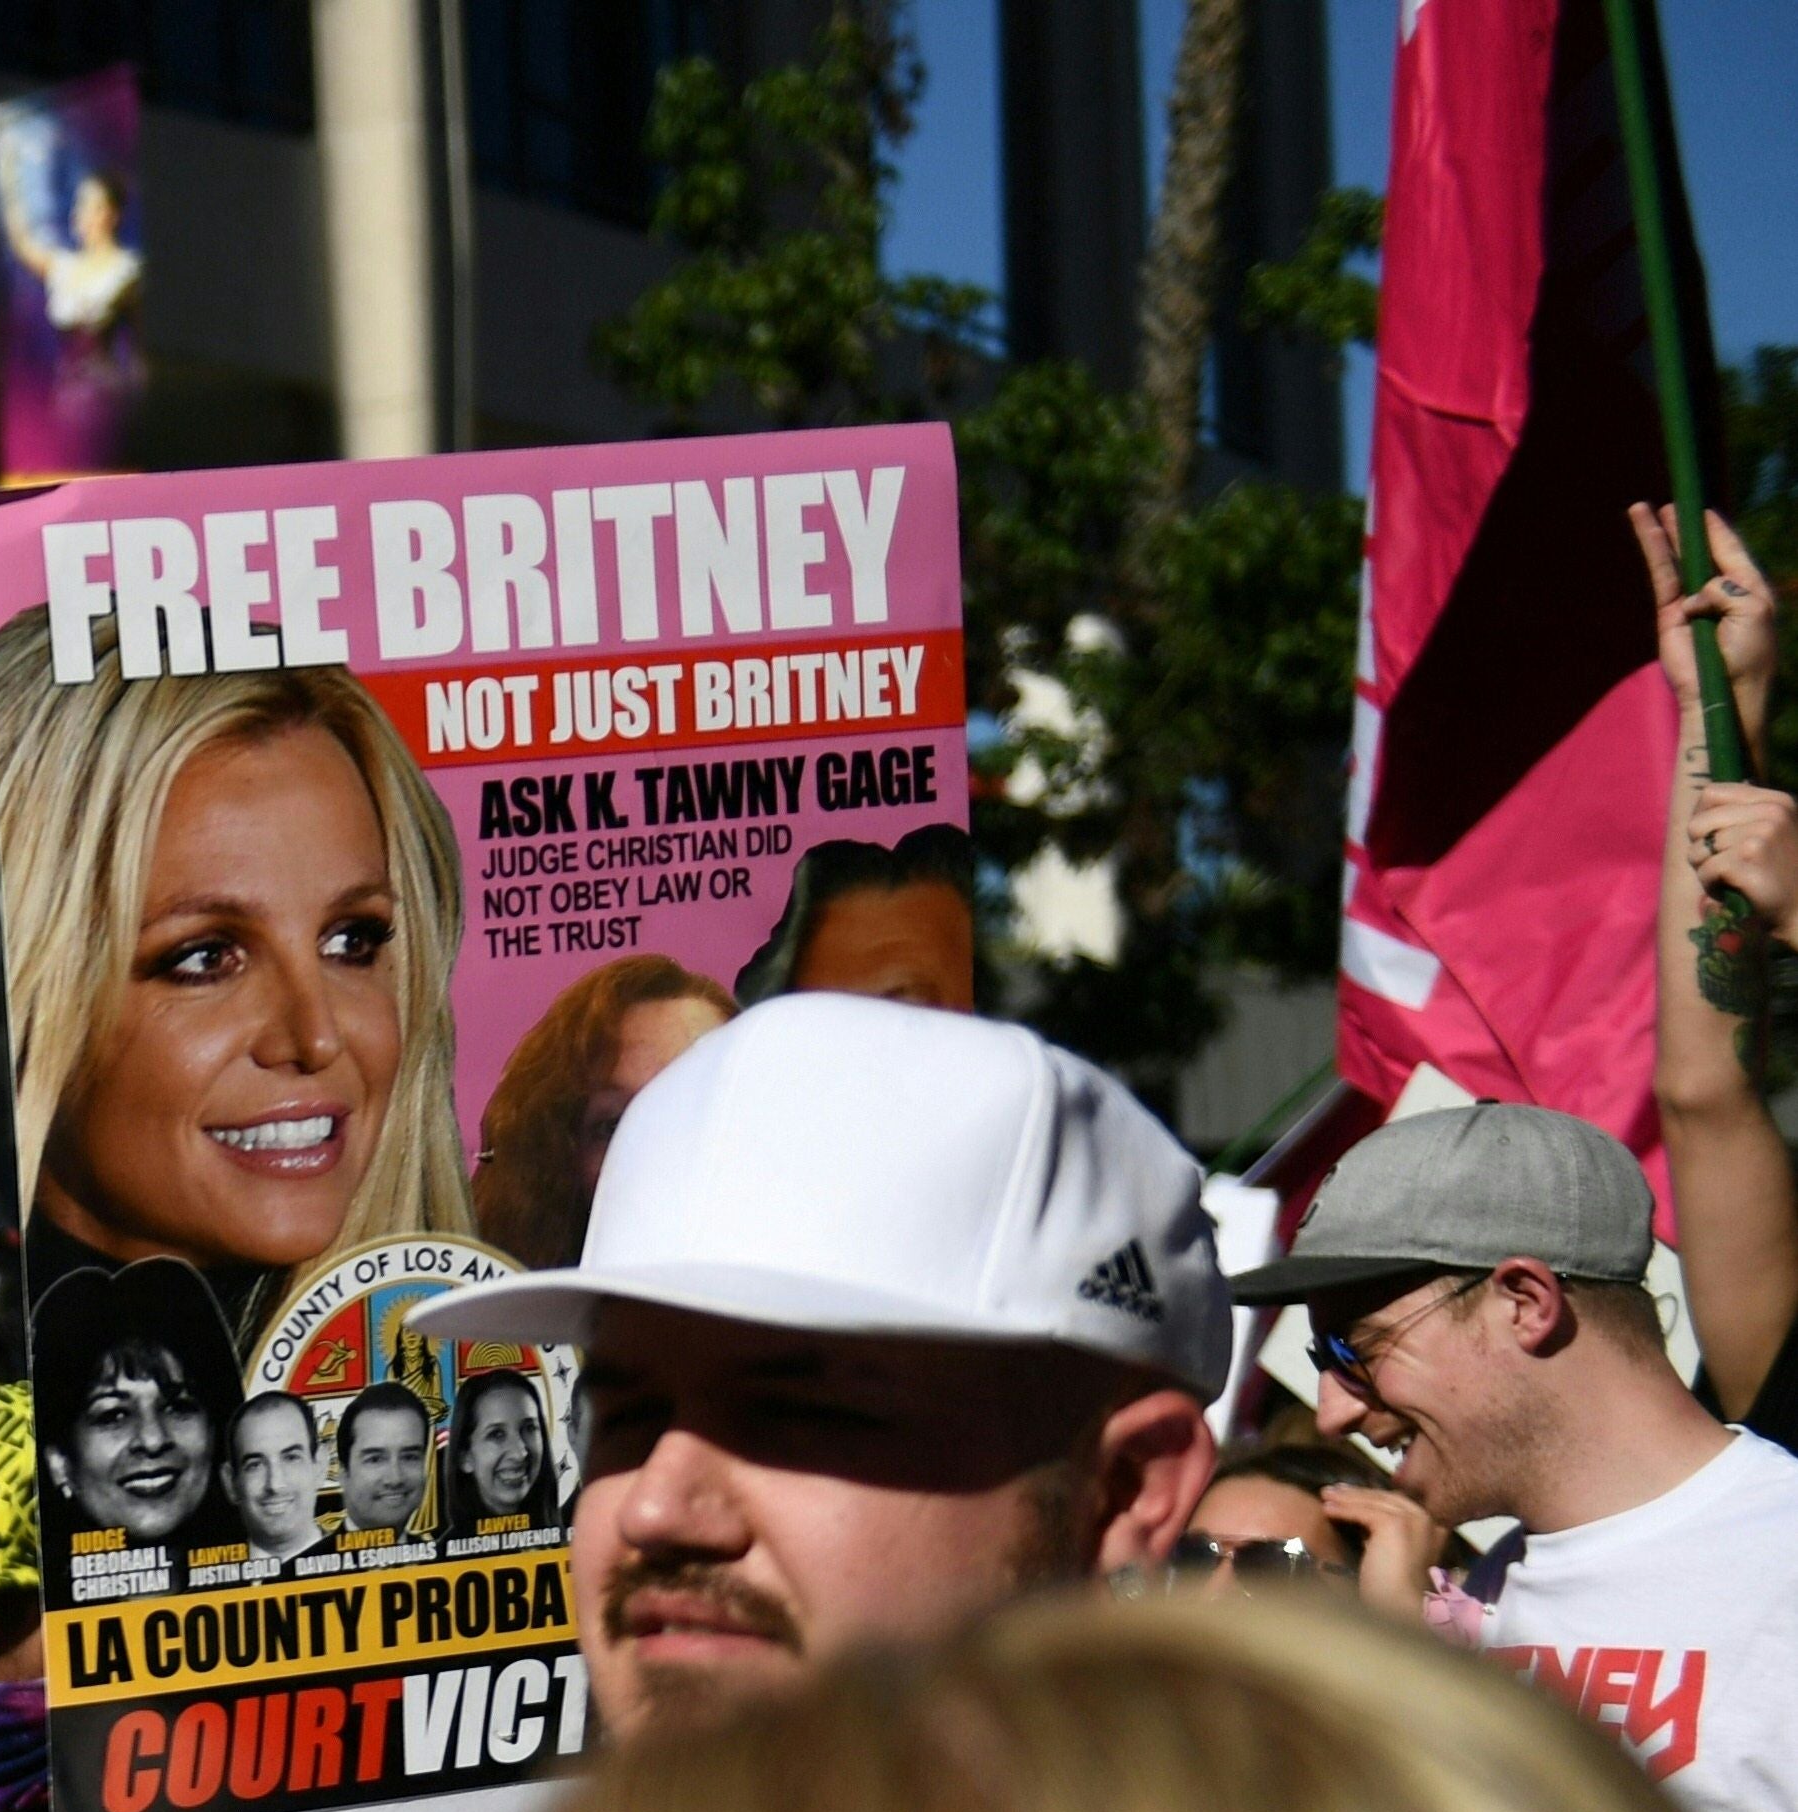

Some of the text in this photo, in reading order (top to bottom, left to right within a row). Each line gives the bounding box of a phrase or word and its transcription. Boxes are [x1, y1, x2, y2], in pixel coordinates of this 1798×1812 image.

[42, 466, 906, 686] FREE BRITNEY
[424, 645, 925, 753] NOT JUST BRITNEY
[479, 744, 937, 839] ASK K. TAWNY GAGE
[482, 824, 792, 880] JUDGE CHRISTIAN DID
[484, 868, 752, 919] NOT OBEY LAW OR
[485, 916, 642, 958] THE TRUST
[262, 1274, 344, 1383] COUNTY
[354, 1252, 391, 1283] OF
[403, 1247, 454, 1273] LOS
[70, 1526, 126, 1555] JUDGE
[337, 1528, 394, 1551] LAWYER
[477, 1514, 530, 1535] LAWYER
[188, 1543, 249, 1567] LAWYER
[445, 1533, 500, 1557] ALLISON
[71, 1547, 158, 1578] DEBORAH
[188, 1563, 240, 1587] JUSTIN
[295, 1554, 341, 1576] DAVID
[72, 1569, 170, 1602] CHRISTIAN
[66, 1561, 577, 1688] LA COUNTY PROBA
